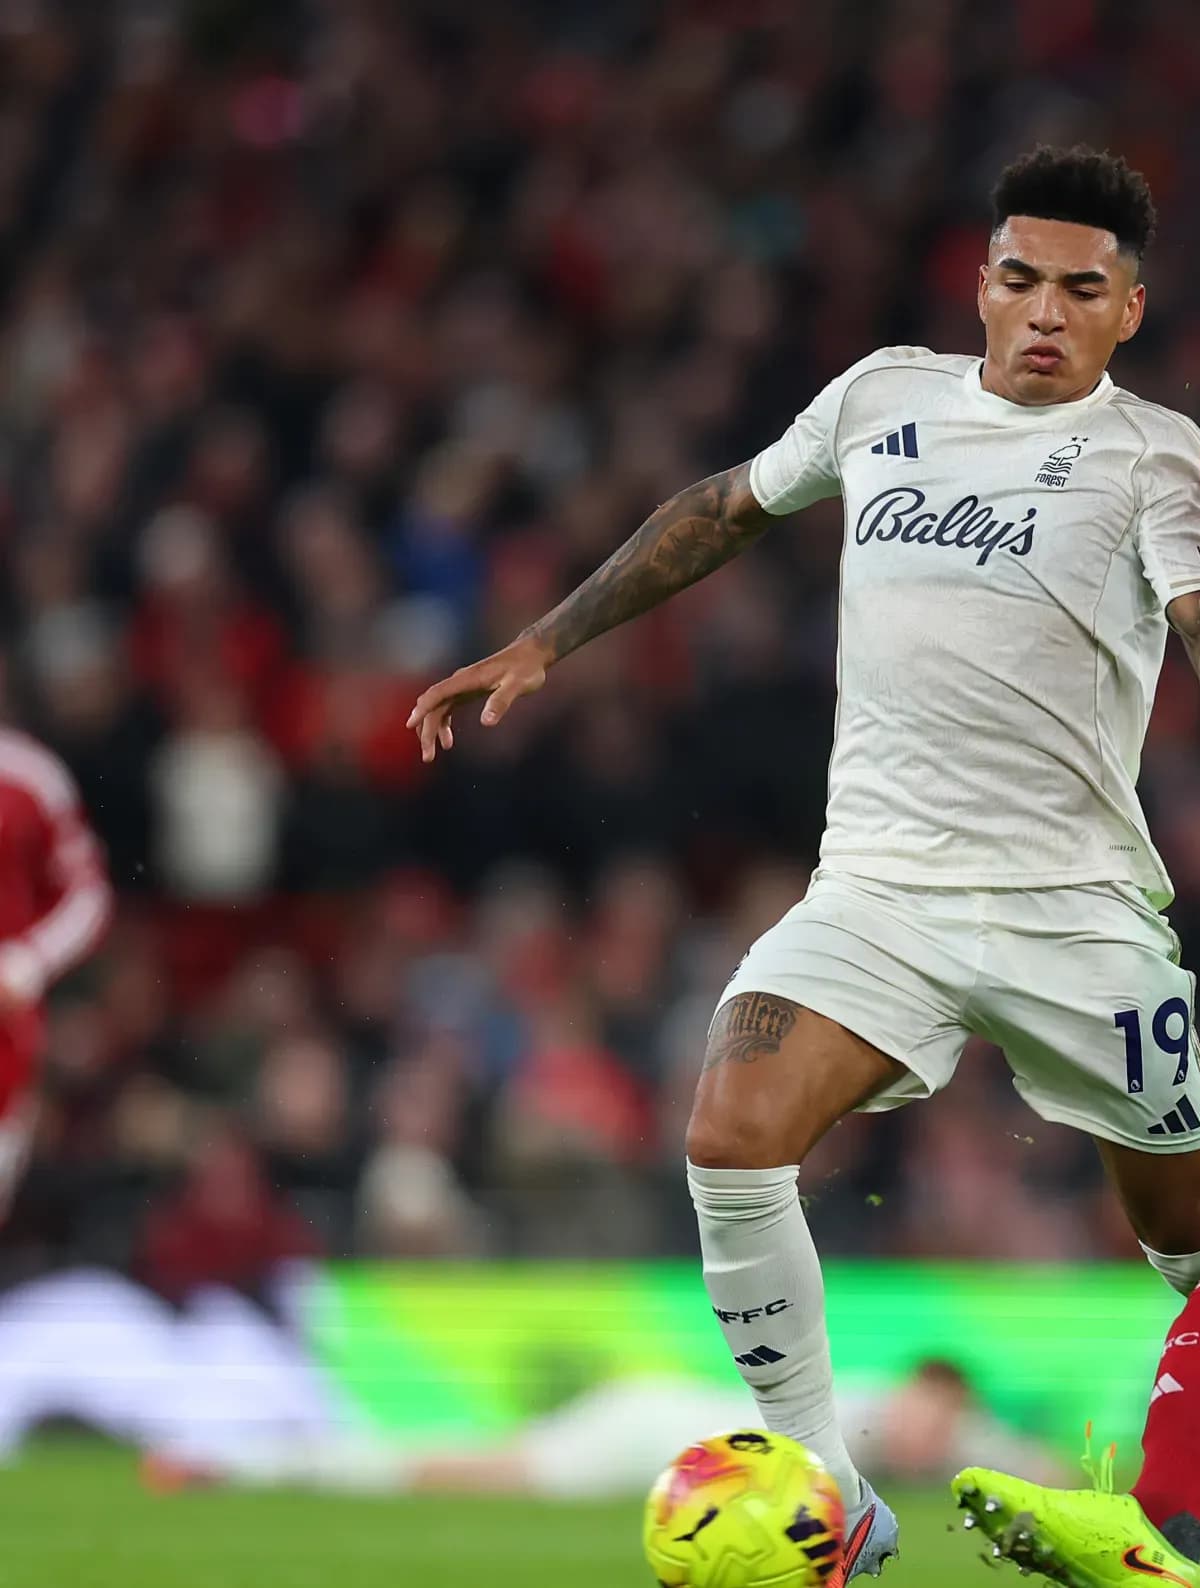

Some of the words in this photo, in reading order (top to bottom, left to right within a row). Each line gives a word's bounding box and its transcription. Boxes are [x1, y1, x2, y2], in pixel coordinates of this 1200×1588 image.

[1034, 472, 1070, 488] FOREST
[856, 487, 1037, 566] Bally's
[1114, 997, 1190, 1094] 19
